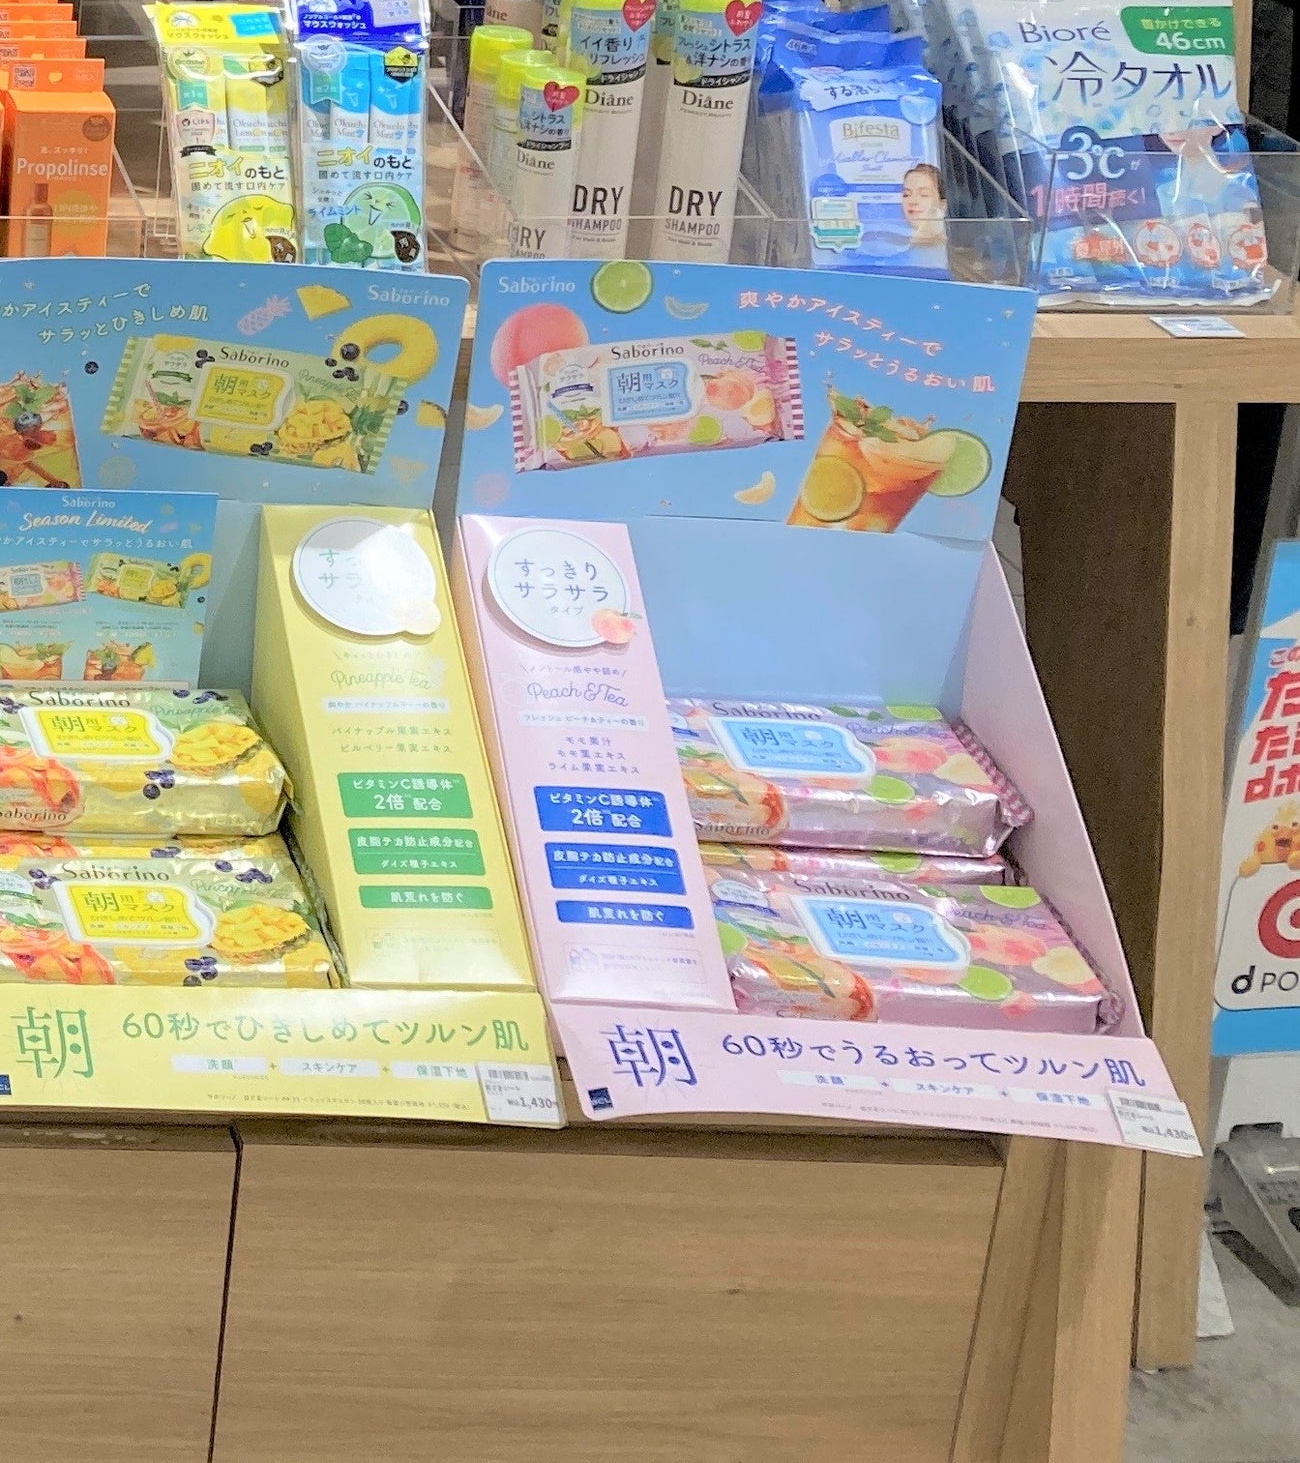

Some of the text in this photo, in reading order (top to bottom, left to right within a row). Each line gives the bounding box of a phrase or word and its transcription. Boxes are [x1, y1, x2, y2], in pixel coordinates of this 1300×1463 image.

[1018, 20, 1112, 45] Bioré
[1156, 32, 1227, 51] 46cm
[580, 36, 632, 52] イイ香り
[1046, 51, 1233, 106] 冷タオル
[584, 88, 635, 107] Diâne
[680, 89, 734, 111] Diâne
[842, 122, 900, 140] Bifesta
[16, 157, 109, 178] Propolinse
[317, 145, 413, 170] ニオイのもと
[573, 184, 624, 215] DRY
[669, 185, 723, 217] DRY
[307, 204, 361, 218] ライムミント
[665, 217, 721, 237] SHAMPOO
[368, 283, 451, 308] Saborino
[498, 276, 576, 296] Saborino
[38, 304, 210, 345] サラッとひきしめ肌
[738, 290, 942, 358] 爽やかアイスティーで
[219, 345, 291, 368] Saborino
[610, 343, 685, 361] Saborino
[814, 330, 995, 394] サラッとうるおい肌
[61, 496, 116, 509] Saborino
[19, 511, 153, 533] Season Limited
[514, 557, 600, 581] すっきり
[514, 581, 609, 604] サラサラ
[374, 794, 442, 811] 2倍 配合
[571, 808, 642, 828] 2倍 配合
[390, 892, 465, 904] 肌荒れを防ぐ
[122, 1011, 531, 1053] 60秒でひきしめてツルン肌
[11, 1007, 94, 1081] 朝
[600, 1023, 700, 1089] 朝
[722, 1033, 1148, 1089] 60秒でうるおってツルン肌
[301, 1061, 358, 1074] スキンケア
[417, 1065, 468, 1079] 保湿下地
[915, 1082, 975, 1097] スキンケア
